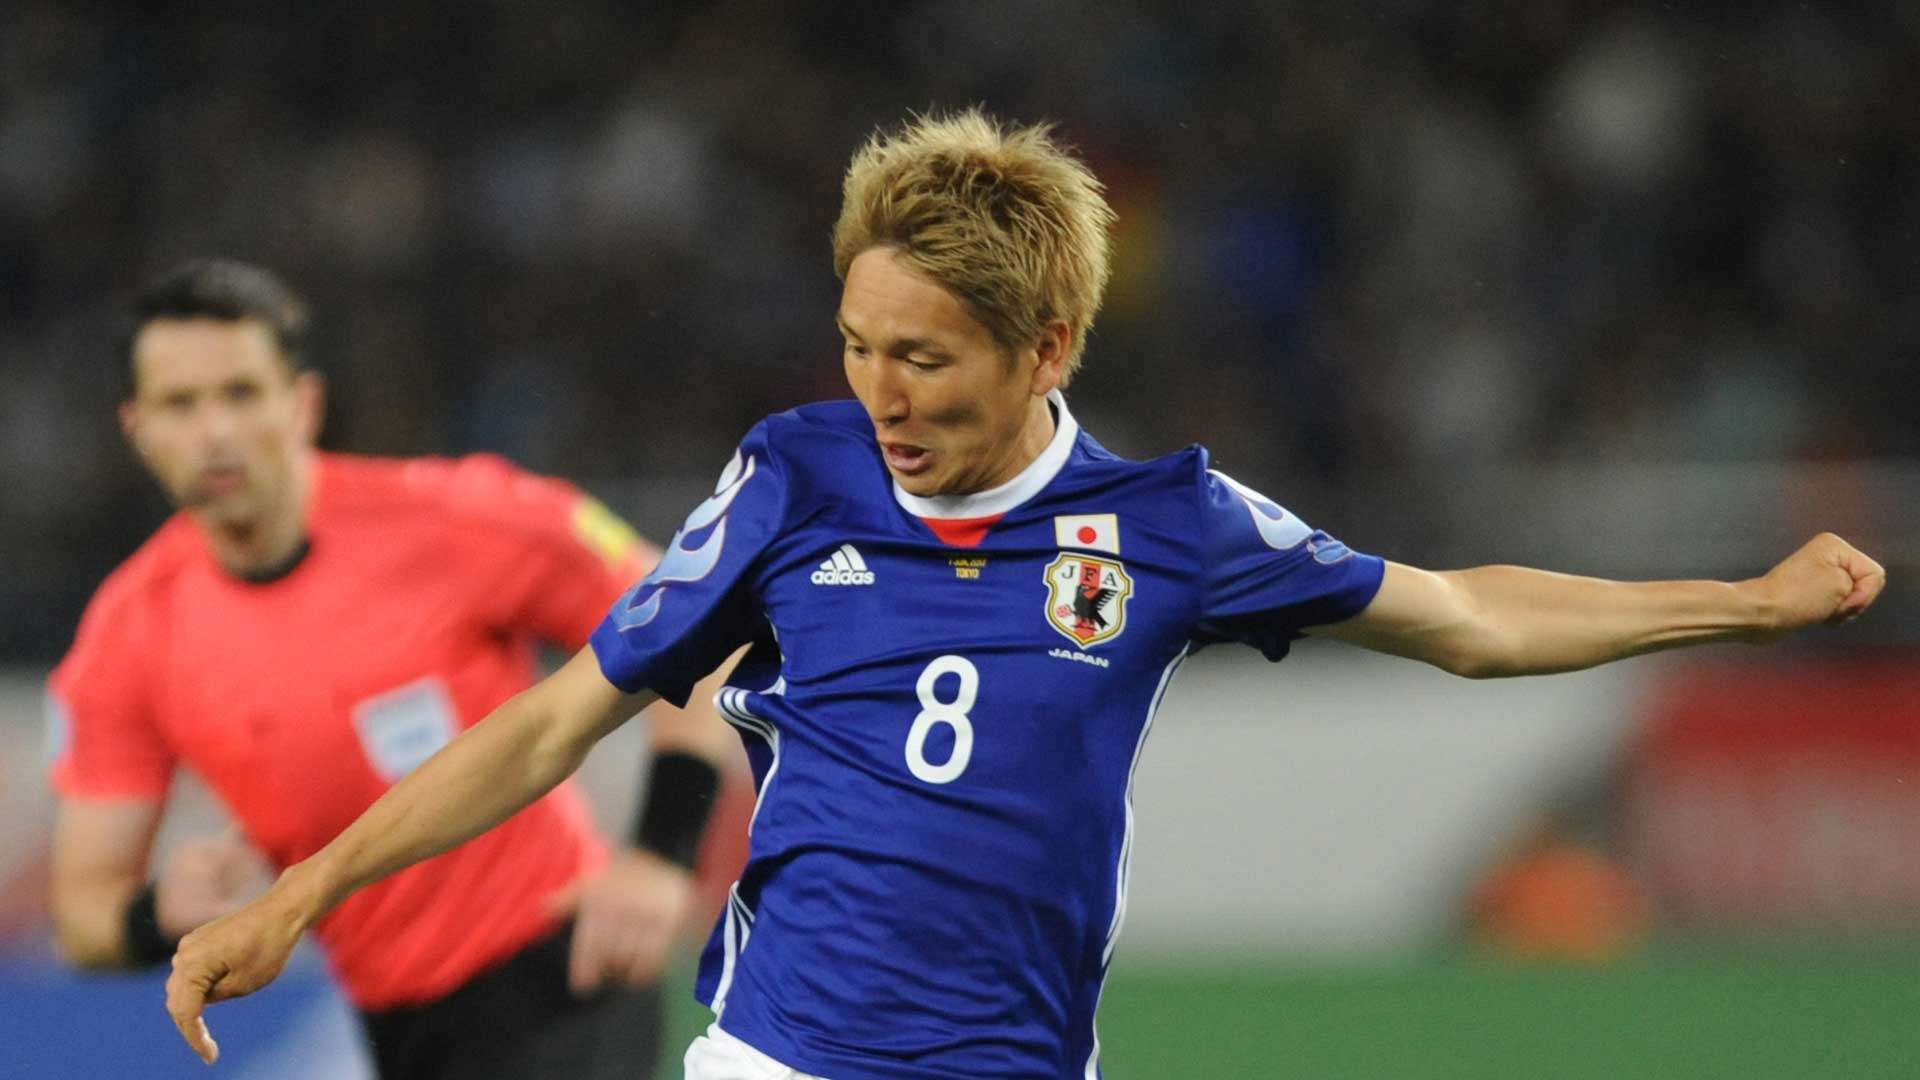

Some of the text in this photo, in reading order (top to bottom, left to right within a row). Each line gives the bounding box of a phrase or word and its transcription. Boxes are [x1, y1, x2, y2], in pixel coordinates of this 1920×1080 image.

[810, 569, 876, 586] adidas
[1048, 648, 1110, 668] JAPAN
[905, 654, 979, 784] 8
